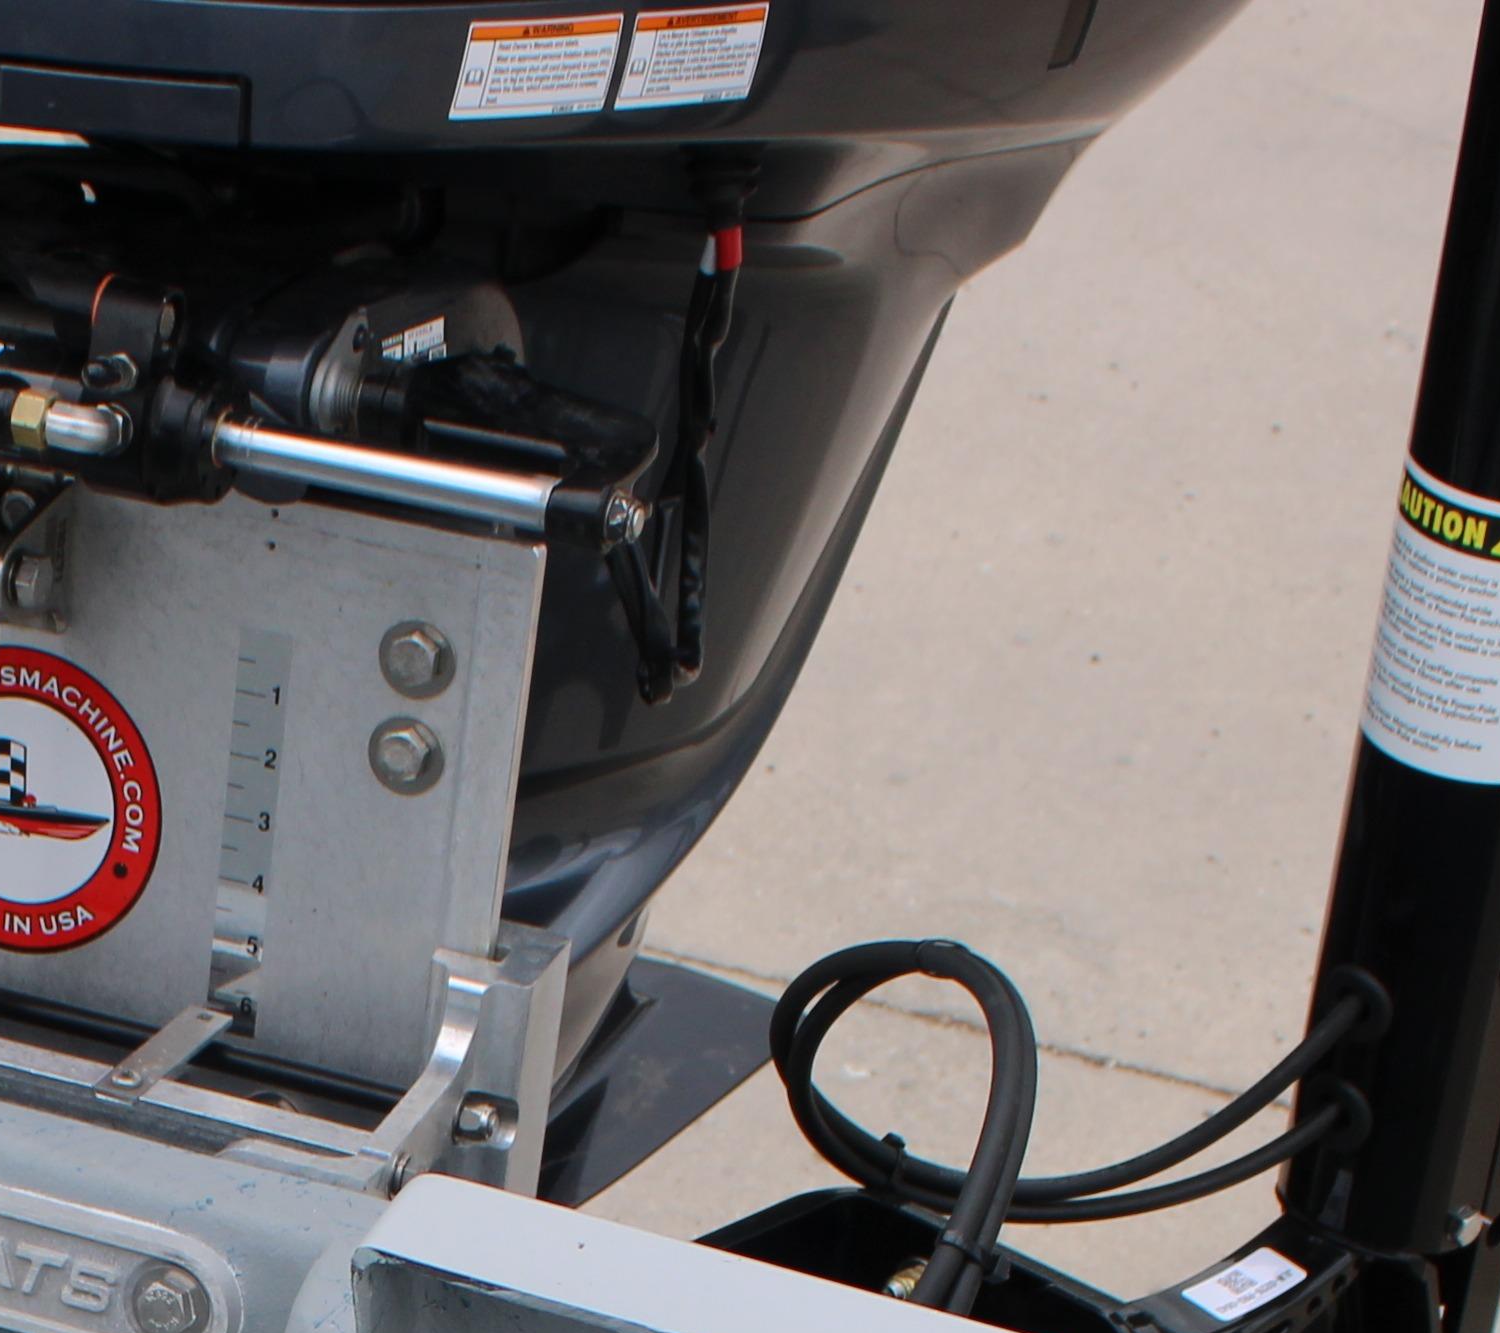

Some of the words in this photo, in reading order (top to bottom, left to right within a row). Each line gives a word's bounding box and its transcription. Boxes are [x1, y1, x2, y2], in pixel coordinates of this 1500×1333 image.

[532, 23, 575, 35] WARNING
[1401, 479, 1488, 550] AUTION
[272, 685, 281, 706] 1
[263, 748, 277, 770] 2
[258, 811, 271, 832] 3
[252, 874, 264, 895] 4
[4, 912, 31, 935] IN
[40, 905, 95, 935] USA
[246, 935, 258, 957] 5
